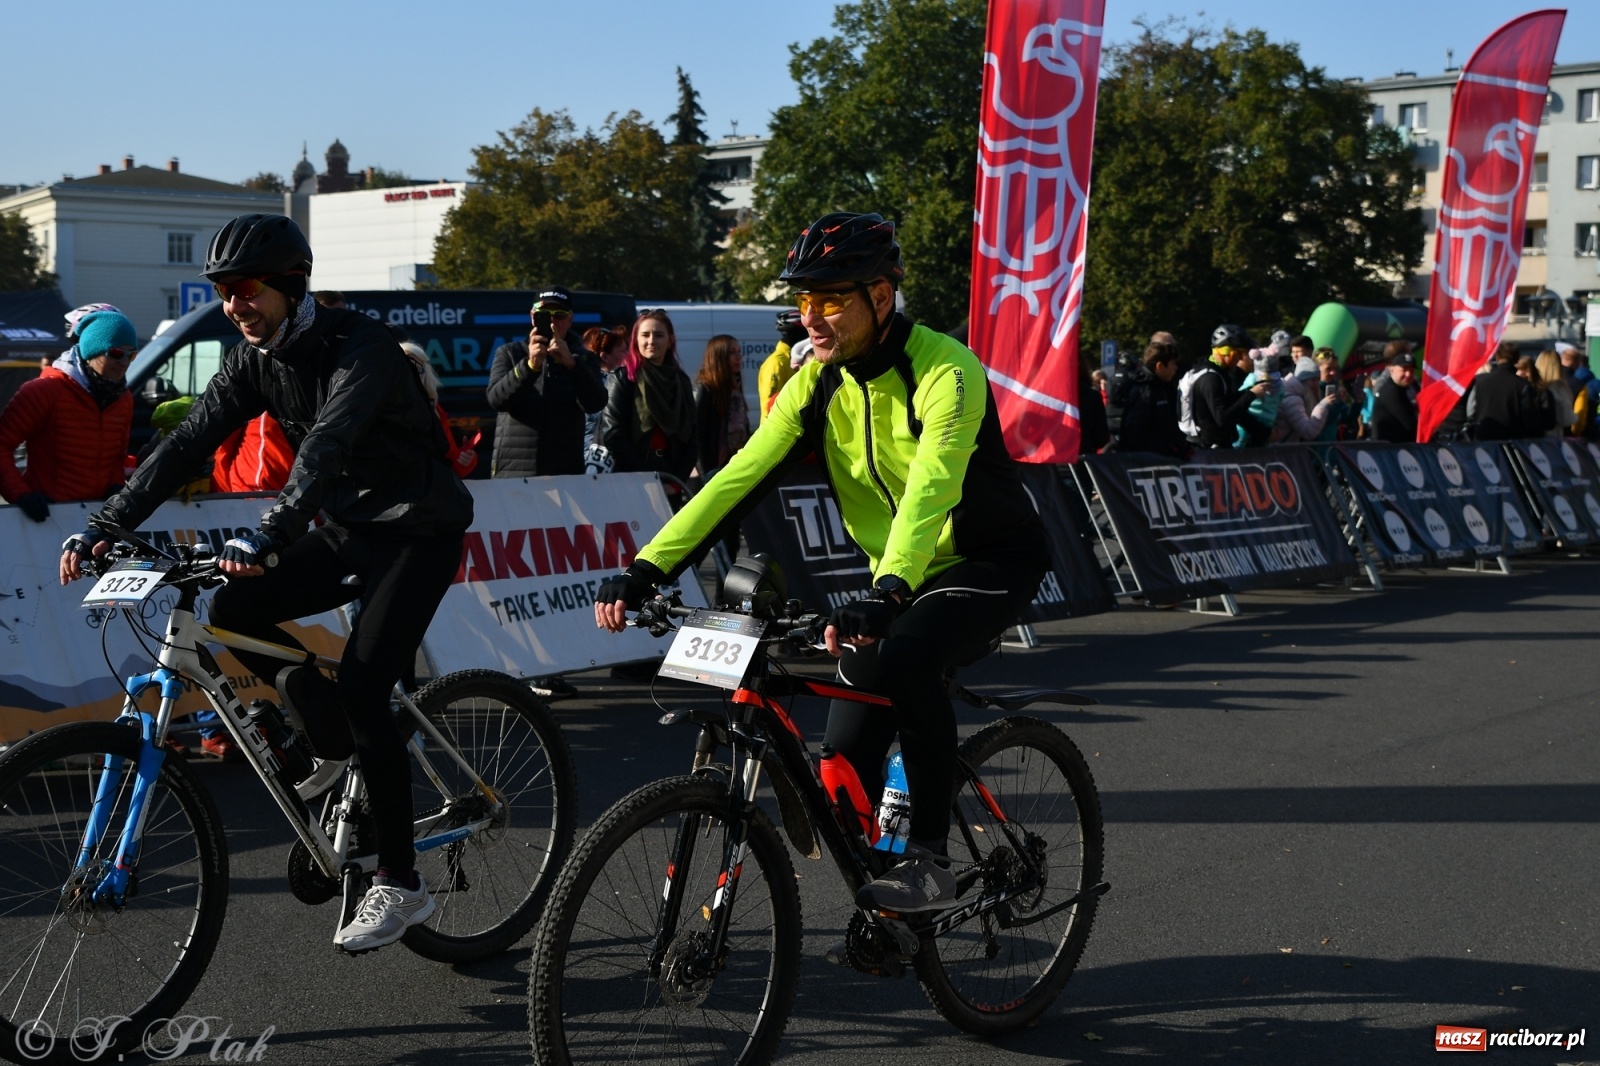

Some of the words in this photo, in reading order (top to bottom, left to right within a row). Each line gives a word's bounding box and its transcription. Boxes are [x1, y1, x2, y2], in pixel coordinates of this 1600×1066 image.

[539, 291, 568, 300] HEAD
[387, 303, 467, 325] atelier
[1132, 467, 1299, 523] TREZADO
[100, 576, 148, 593] 3173
[490, 591, 546, 626] TAKE
[685, 637, 742, 665] 3193
[721, 843, 739, 906] KROSS
[934, 891, 1013, 937] LEVEL
